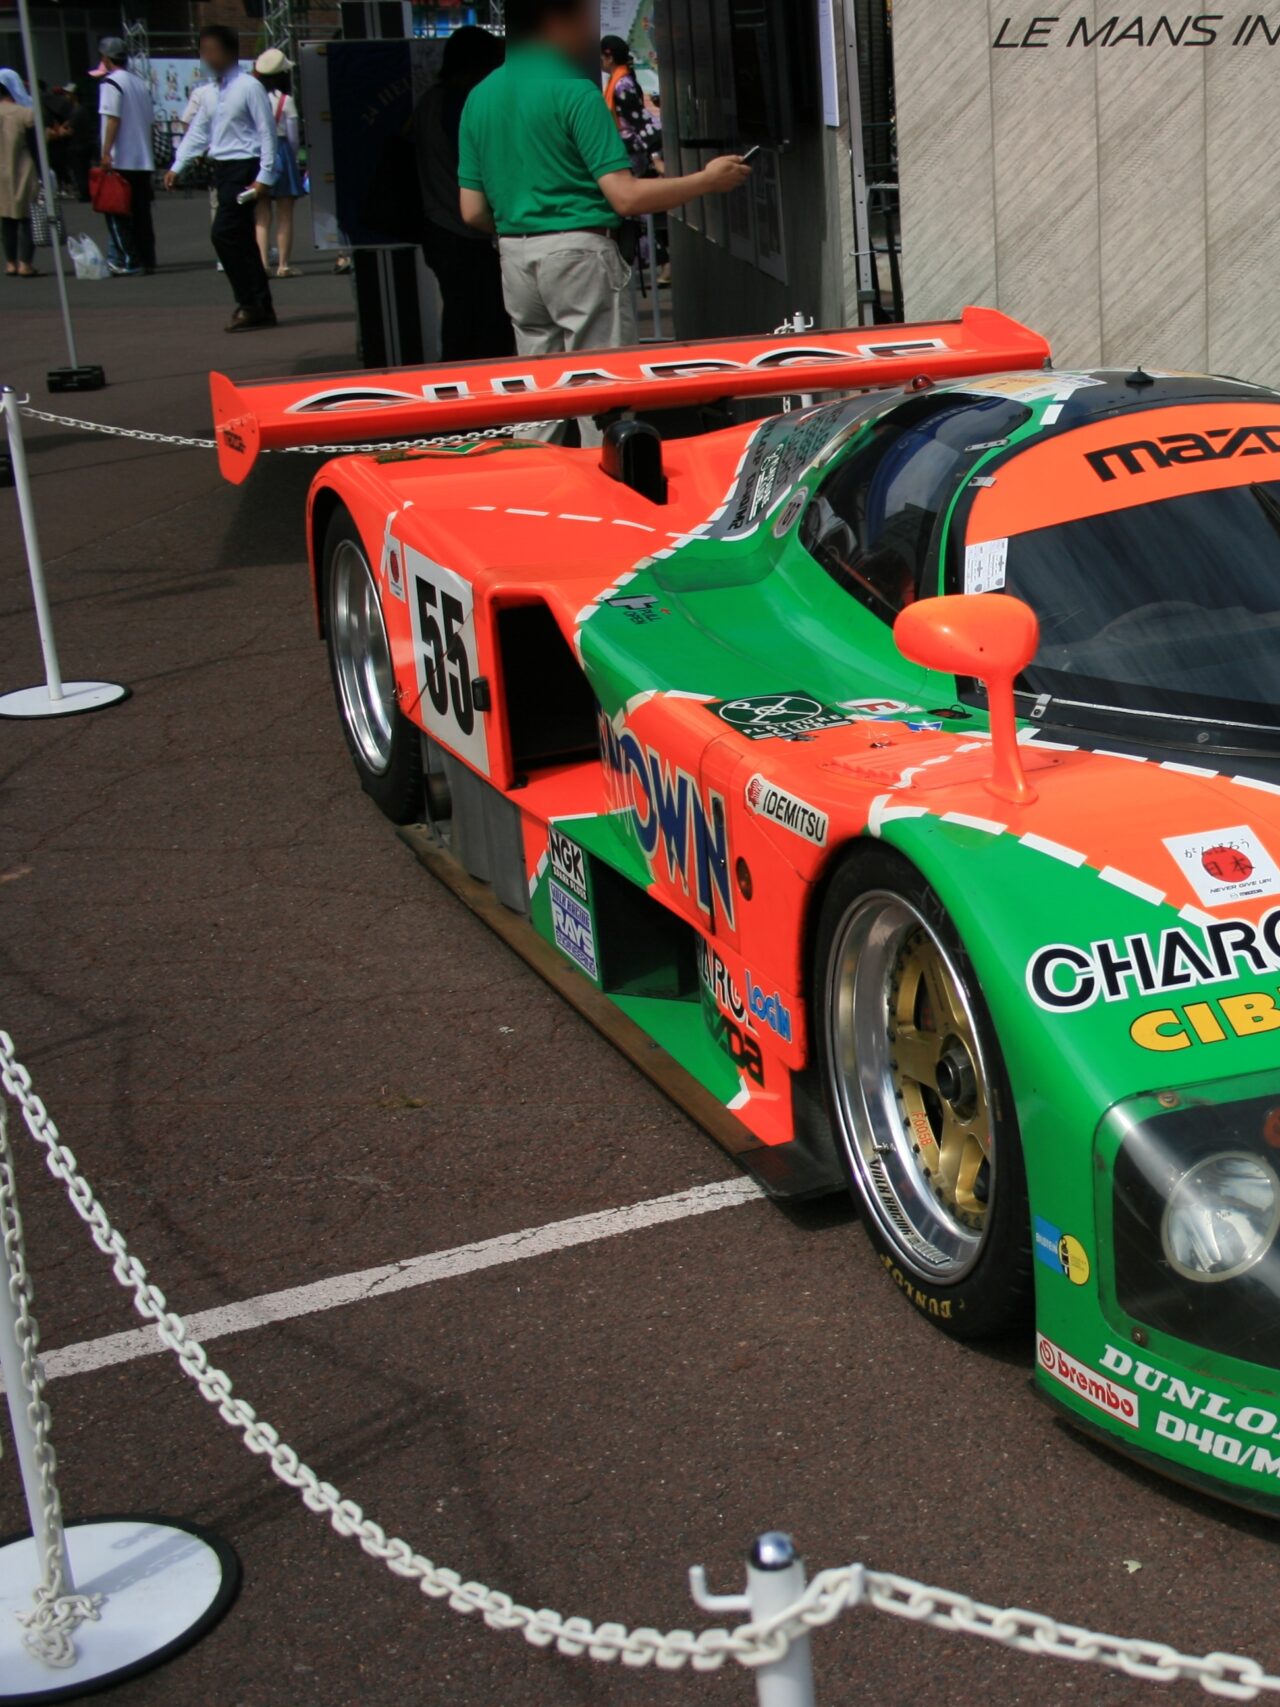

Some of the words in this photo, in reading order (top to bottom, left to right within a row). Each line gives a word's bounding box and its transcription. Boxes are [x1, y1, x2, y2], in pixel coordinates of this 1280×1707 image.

[993, 17, 1059, 48] LE
[1066, 15, 1223, 47] MANS
[414, 574, 475, 736] 55
[762, 789, 827, 843] IDEMITSU
[550, 831, 585, 887] NGK
[1210, 884, 1237, 894] NEVER
[1238, 881, 1257, 889] GIVE
[553, 903, 595, 962] RAYS
[1057, 1352, 1135, 1418] brembo
